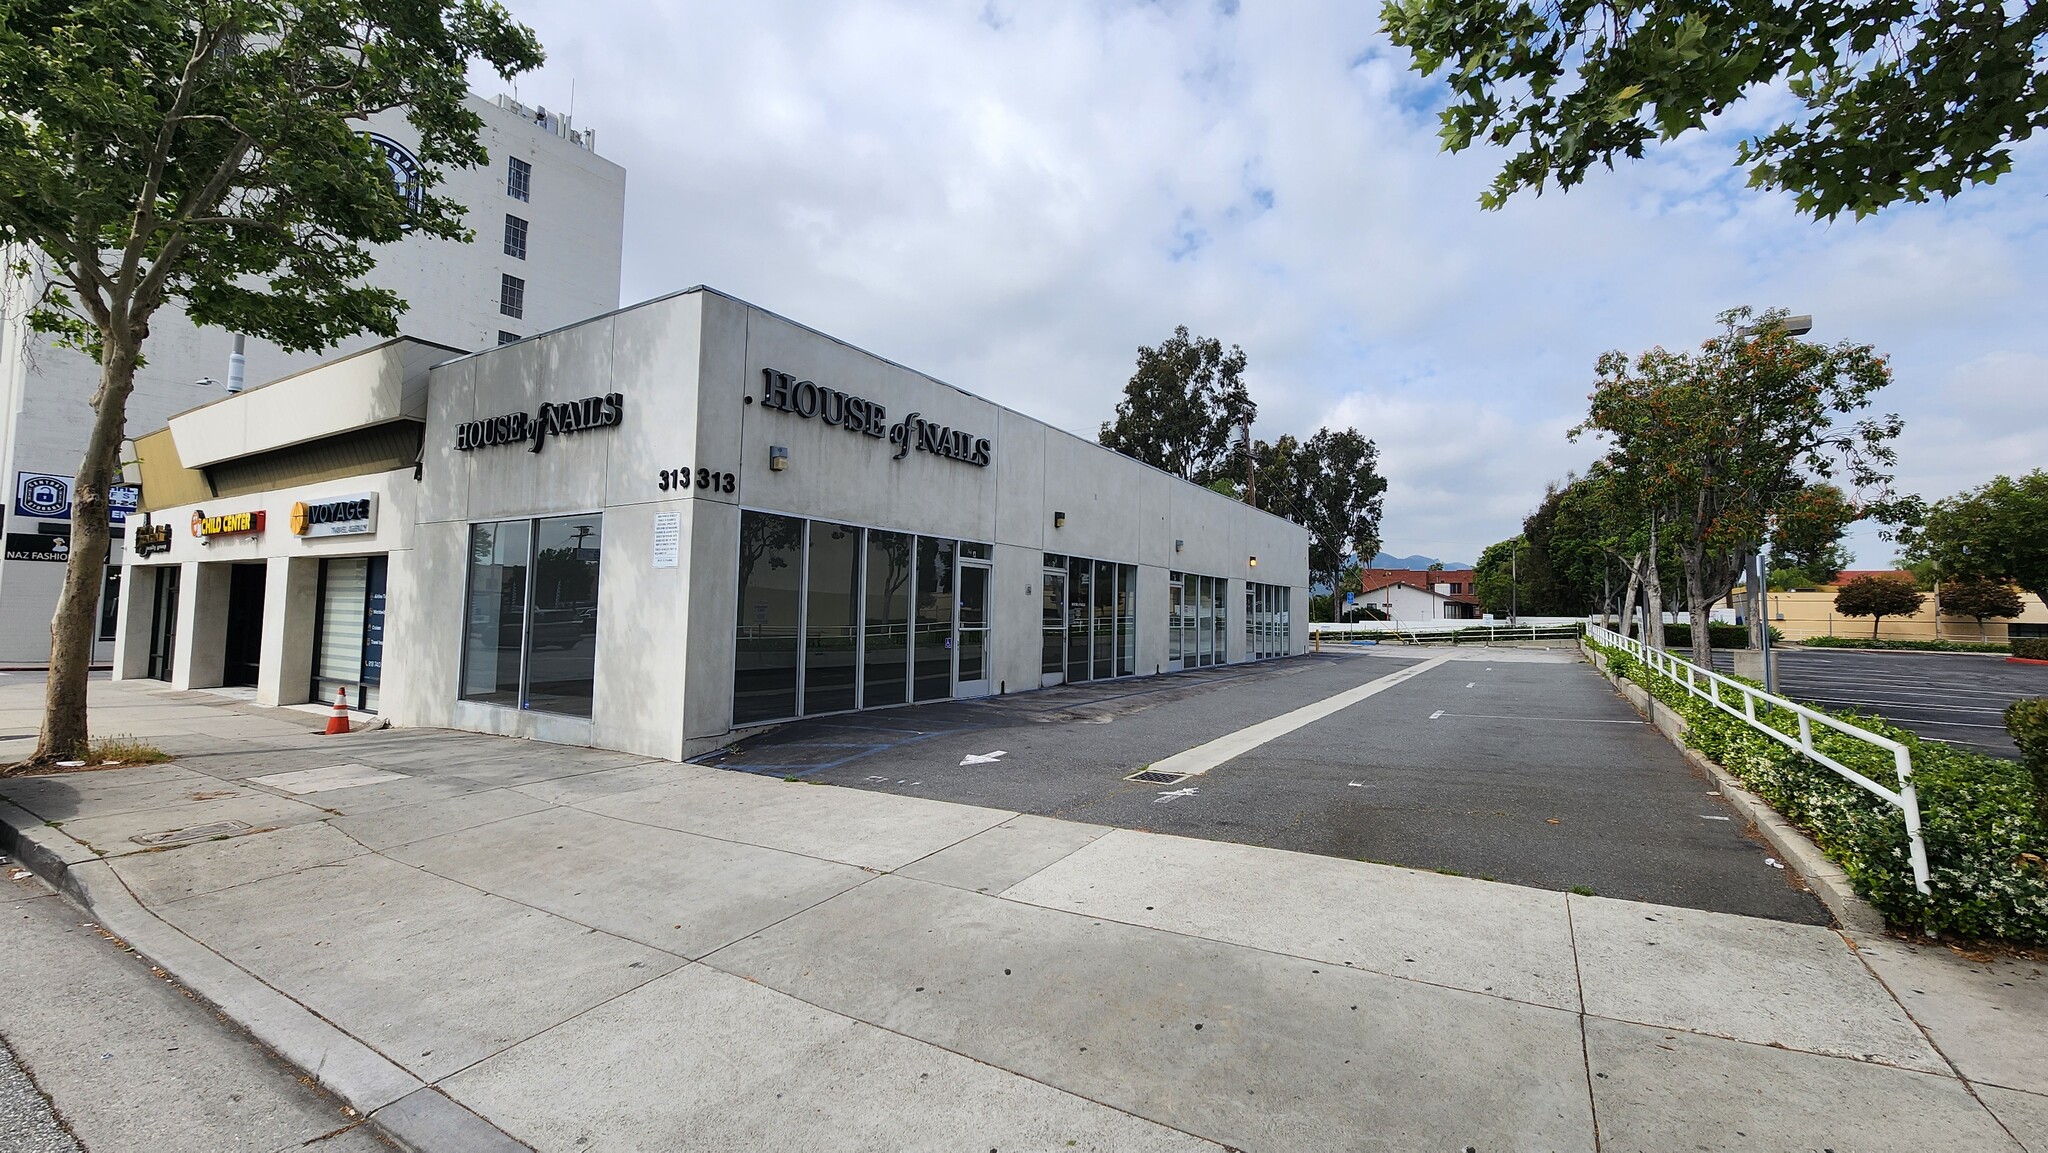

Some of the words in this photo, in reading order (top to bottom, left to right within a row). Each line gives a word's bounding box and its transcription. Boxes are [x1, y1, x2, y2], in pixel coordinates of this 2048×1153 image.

[454, 412, 527, 451] HOUSE
[525, 402, 552, 453] of
[546, 392, 624, 436] NAILS
[761, 368, 887, 438] HOUSE
[890, 412, 920, 460] of
[916, 419, 991, 467] NAILS
[659, 466, 690, 491] 313
[697, 468, 735, 493] 313
[201, 516, 221, 535] CHILD
[223, 512, 250, 532] CENTER
[309, 500, 367, 524] VOYAGE
[7, 551, 29, 559] NAZ
[31, 552, 68, 560] FASHIO
